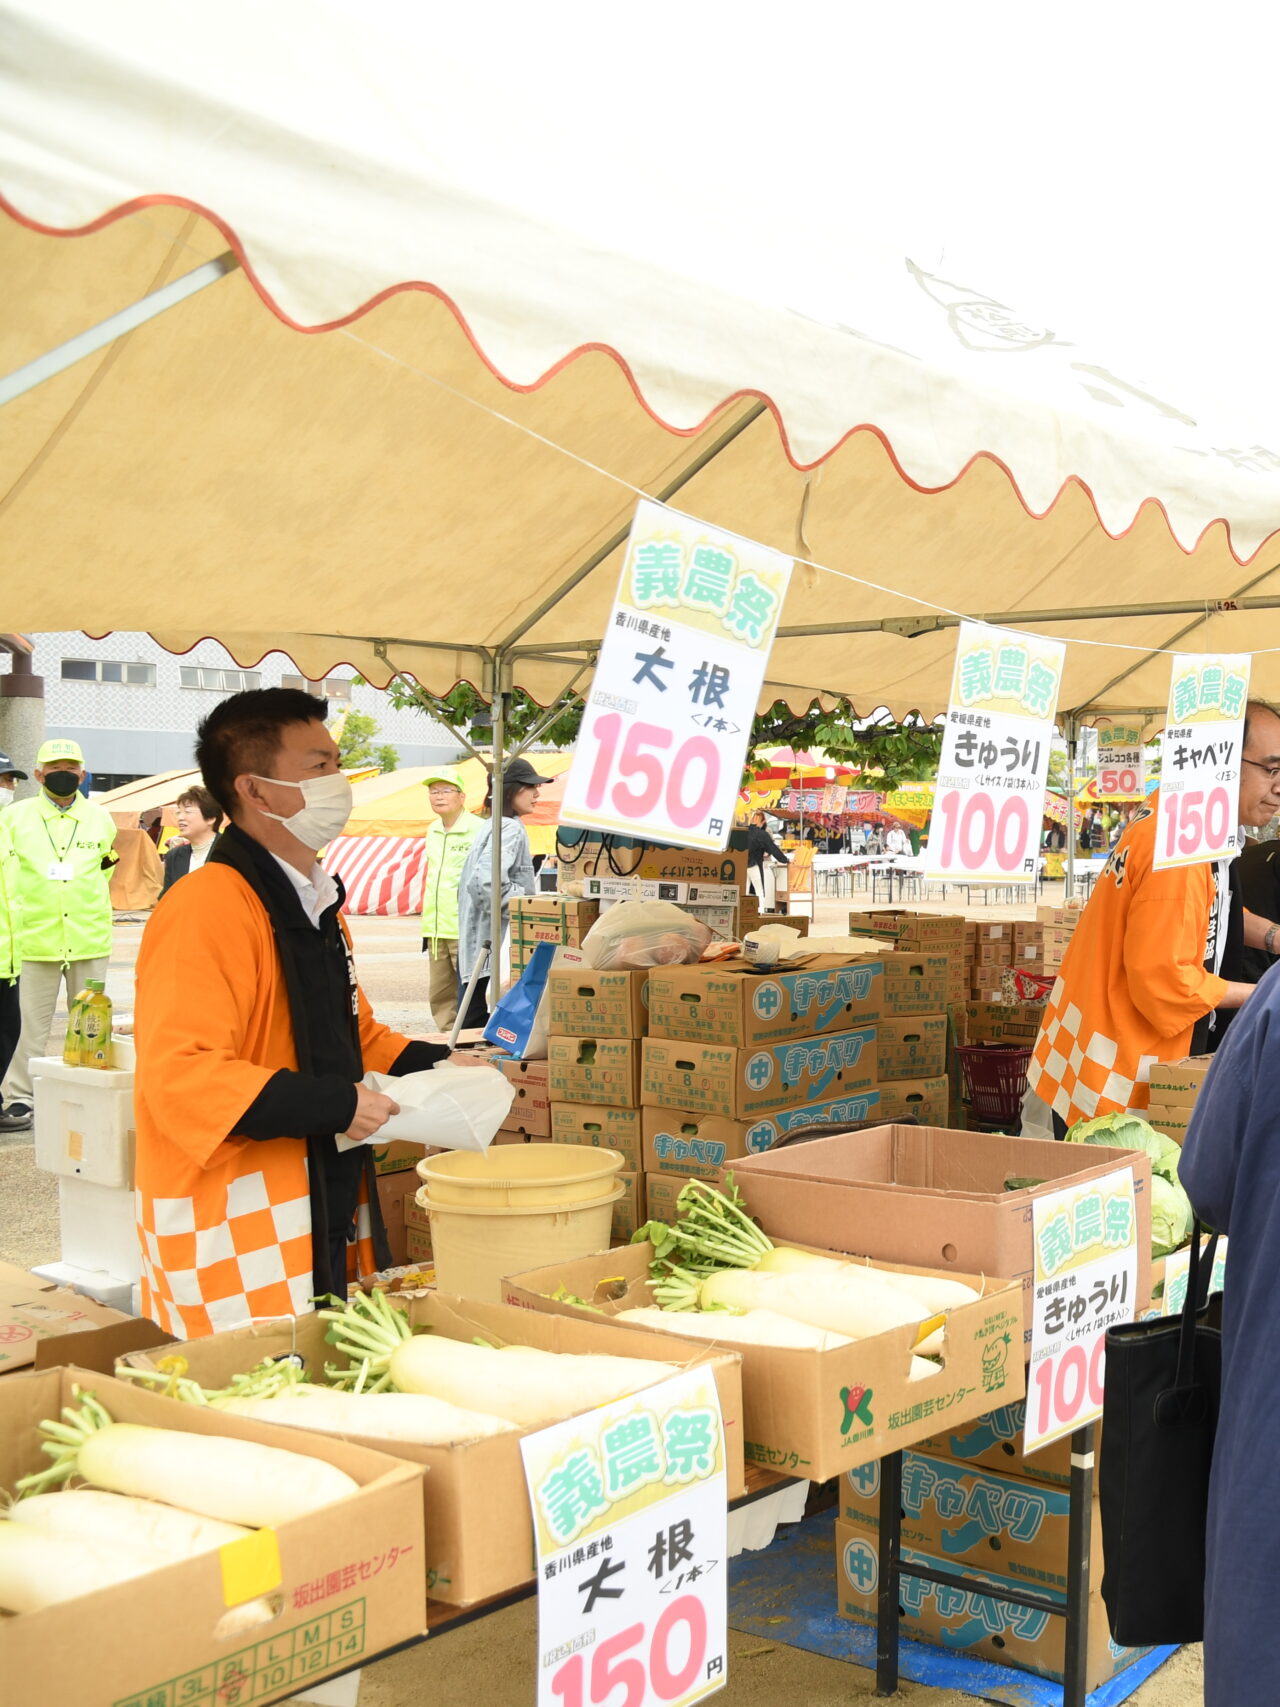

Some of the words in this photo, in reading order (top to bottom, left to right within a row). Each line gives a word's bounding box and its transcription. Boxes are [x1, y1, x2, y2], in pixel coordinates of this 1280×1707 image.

[635, 544, 774, 639] 義農祭
[615, 611, 671, 643] 香川県産他
[632, 646, 730, 709] 大根
[961, 648, 1055, 713] 義農祭
[1174, 667, 1246, 718] 義農祭
[950, 712, 991, 729] 愛媛県産他
[585, 712, 721, 829] 150
[954, 731, 1040, 775] きゅうり
[1173, 741, 1234, 770] キャベツ
[1102, 769, 1137, 793] 50
[940, 789, 1029, 872] 100
[1164, 786, 1230, 858] 150
[659, 865, 718, 878] やさしさバナナ
[689, 1005, 698, 1019] 8
[757, 987, 779, 1016] 中
[795, 968, 873, 1011] キャベツ
[683, 1073, 692, 1086] 8
[784, 1035, 863, 1081] キャベツ
[653, 1132, 726, 1167] キャベツ
[1039, 1197, 1131, 1271] 義農祭
[1036, 1275, 1077, 1299] 愛媛県産他
[1043, 1270, 1128, 1335] きゅうり
[888, 1386, 976, 1430] 坂出園芸センター
[542, 1413, 712, 1537] 義農祭
[901, 1460, 1046, 1543] キャベツ
[293, 1545, 413, 1610] 坂出園芸センター
[544, 1535, 613, 1580] 香川県産他
[578, 1518, 695, 1614] 大根
[901, 1560, 1052, 1642] キャベツ
[180, 1675, 208, 1699] 3L
[268, 1642, 279, 1662] L
[303, 1625, 320, 1647] M
[341, 1610, 354, 1630] S
[262, 1666, 286, 1689] 10
[299, 1650, 322, 1672] 12
[336, 1635, 358, 1654] 14
[707, 1656, 723, 1681] 円
